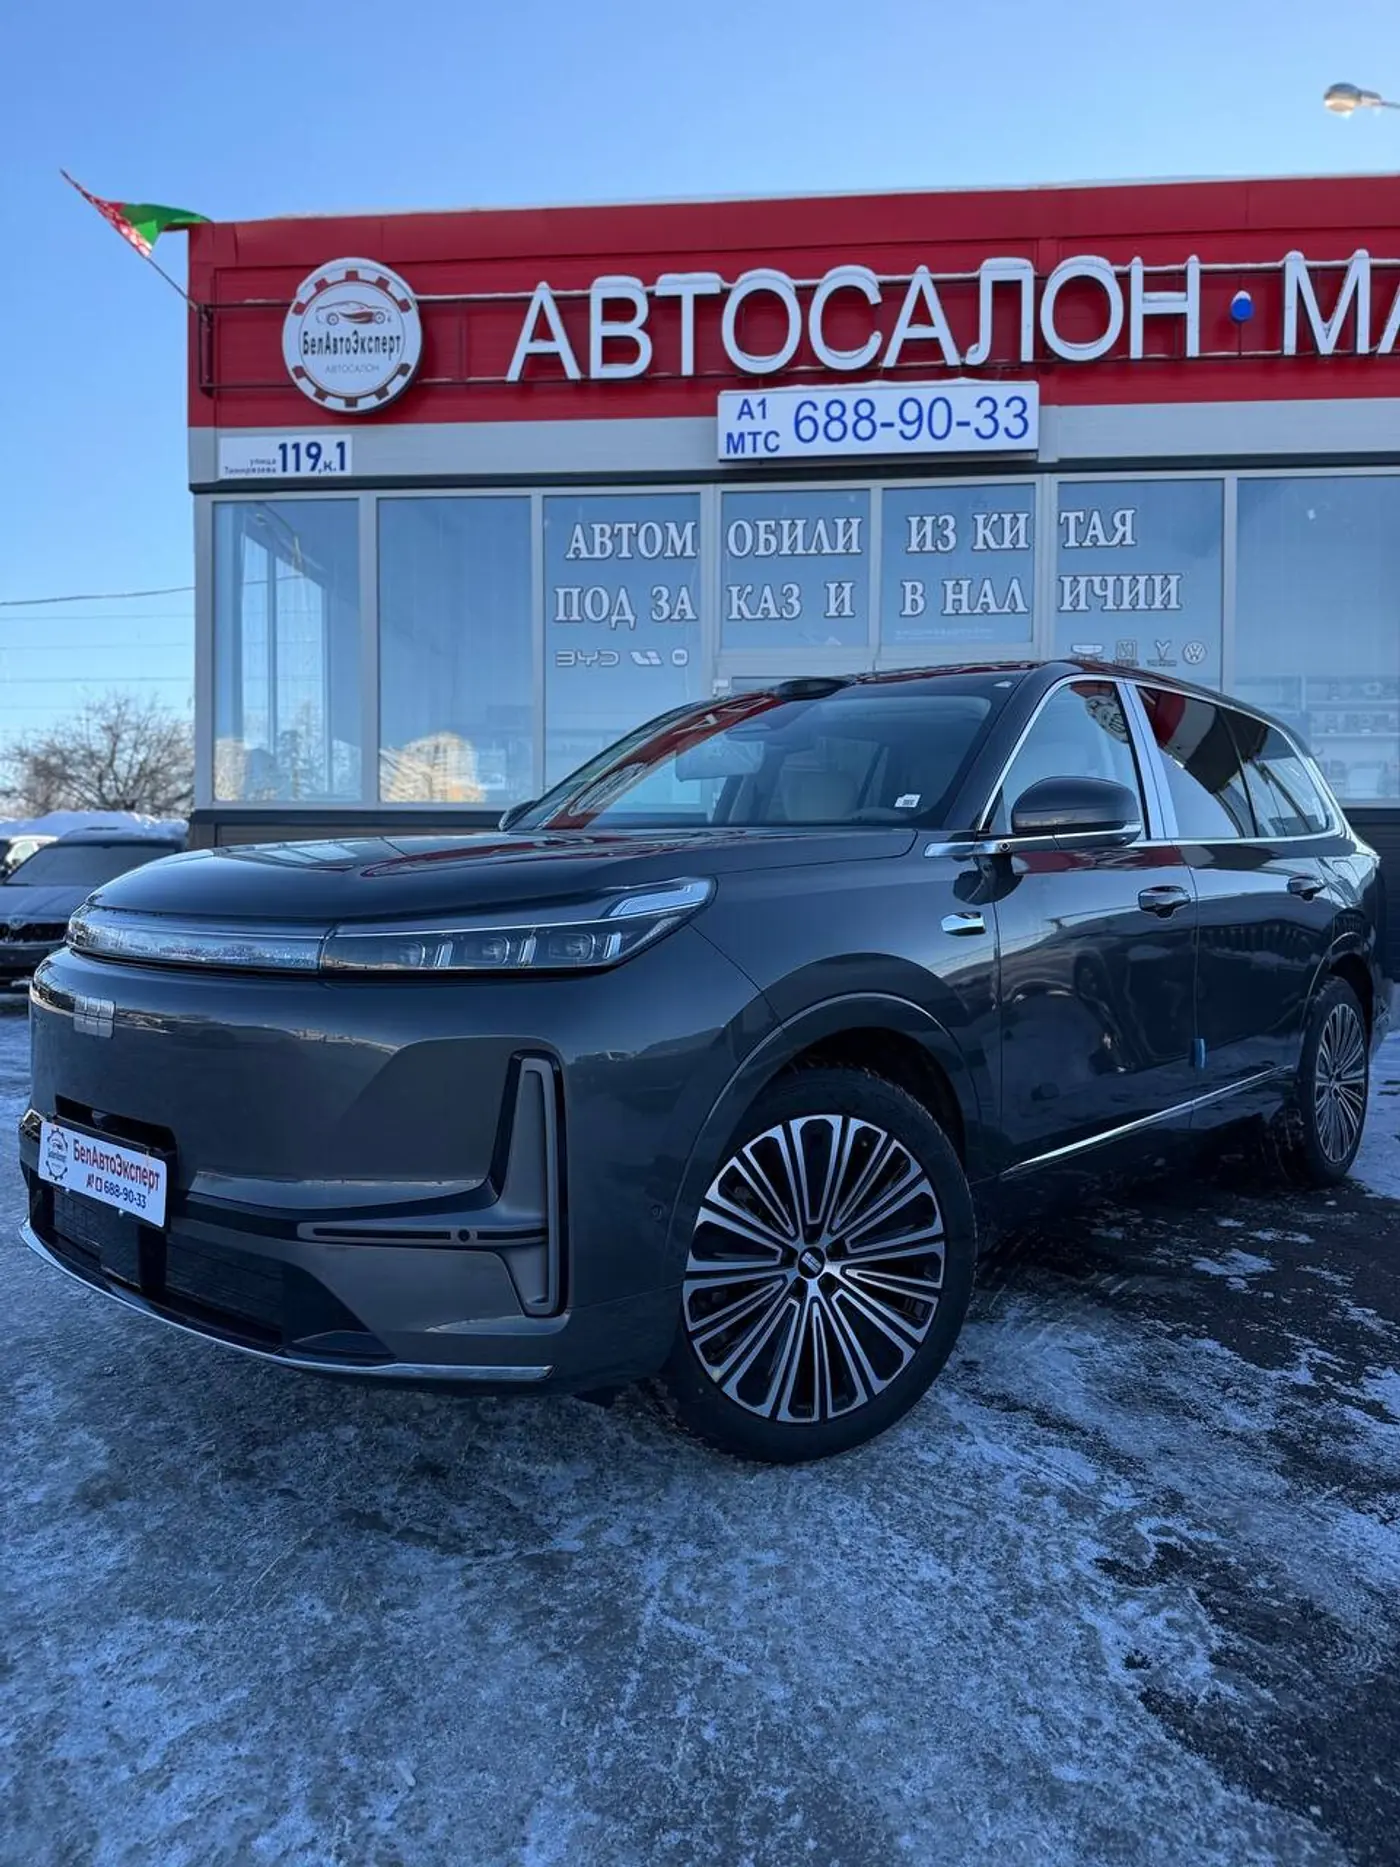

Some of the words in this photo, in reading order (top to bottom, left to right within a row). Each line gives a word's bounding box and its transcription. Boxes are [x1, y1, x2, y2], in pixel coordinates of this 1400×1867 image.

[506, 254, 1200, 383] АВТОСАЛОН
[303, 329, 401, 361] БелАвтоЭксперт
[725, 430, 781, 455] МТС
[793, 395, 1030, 444] 688-90-33
[905, 513, 958, 553] ИЗ
[553, 586, 637, 630] ПОД
[824, 581, 856, 617] И
[899, 579, 926, 617] В
[73, 1139, 160, 1193] БелАвтоЭксперт
